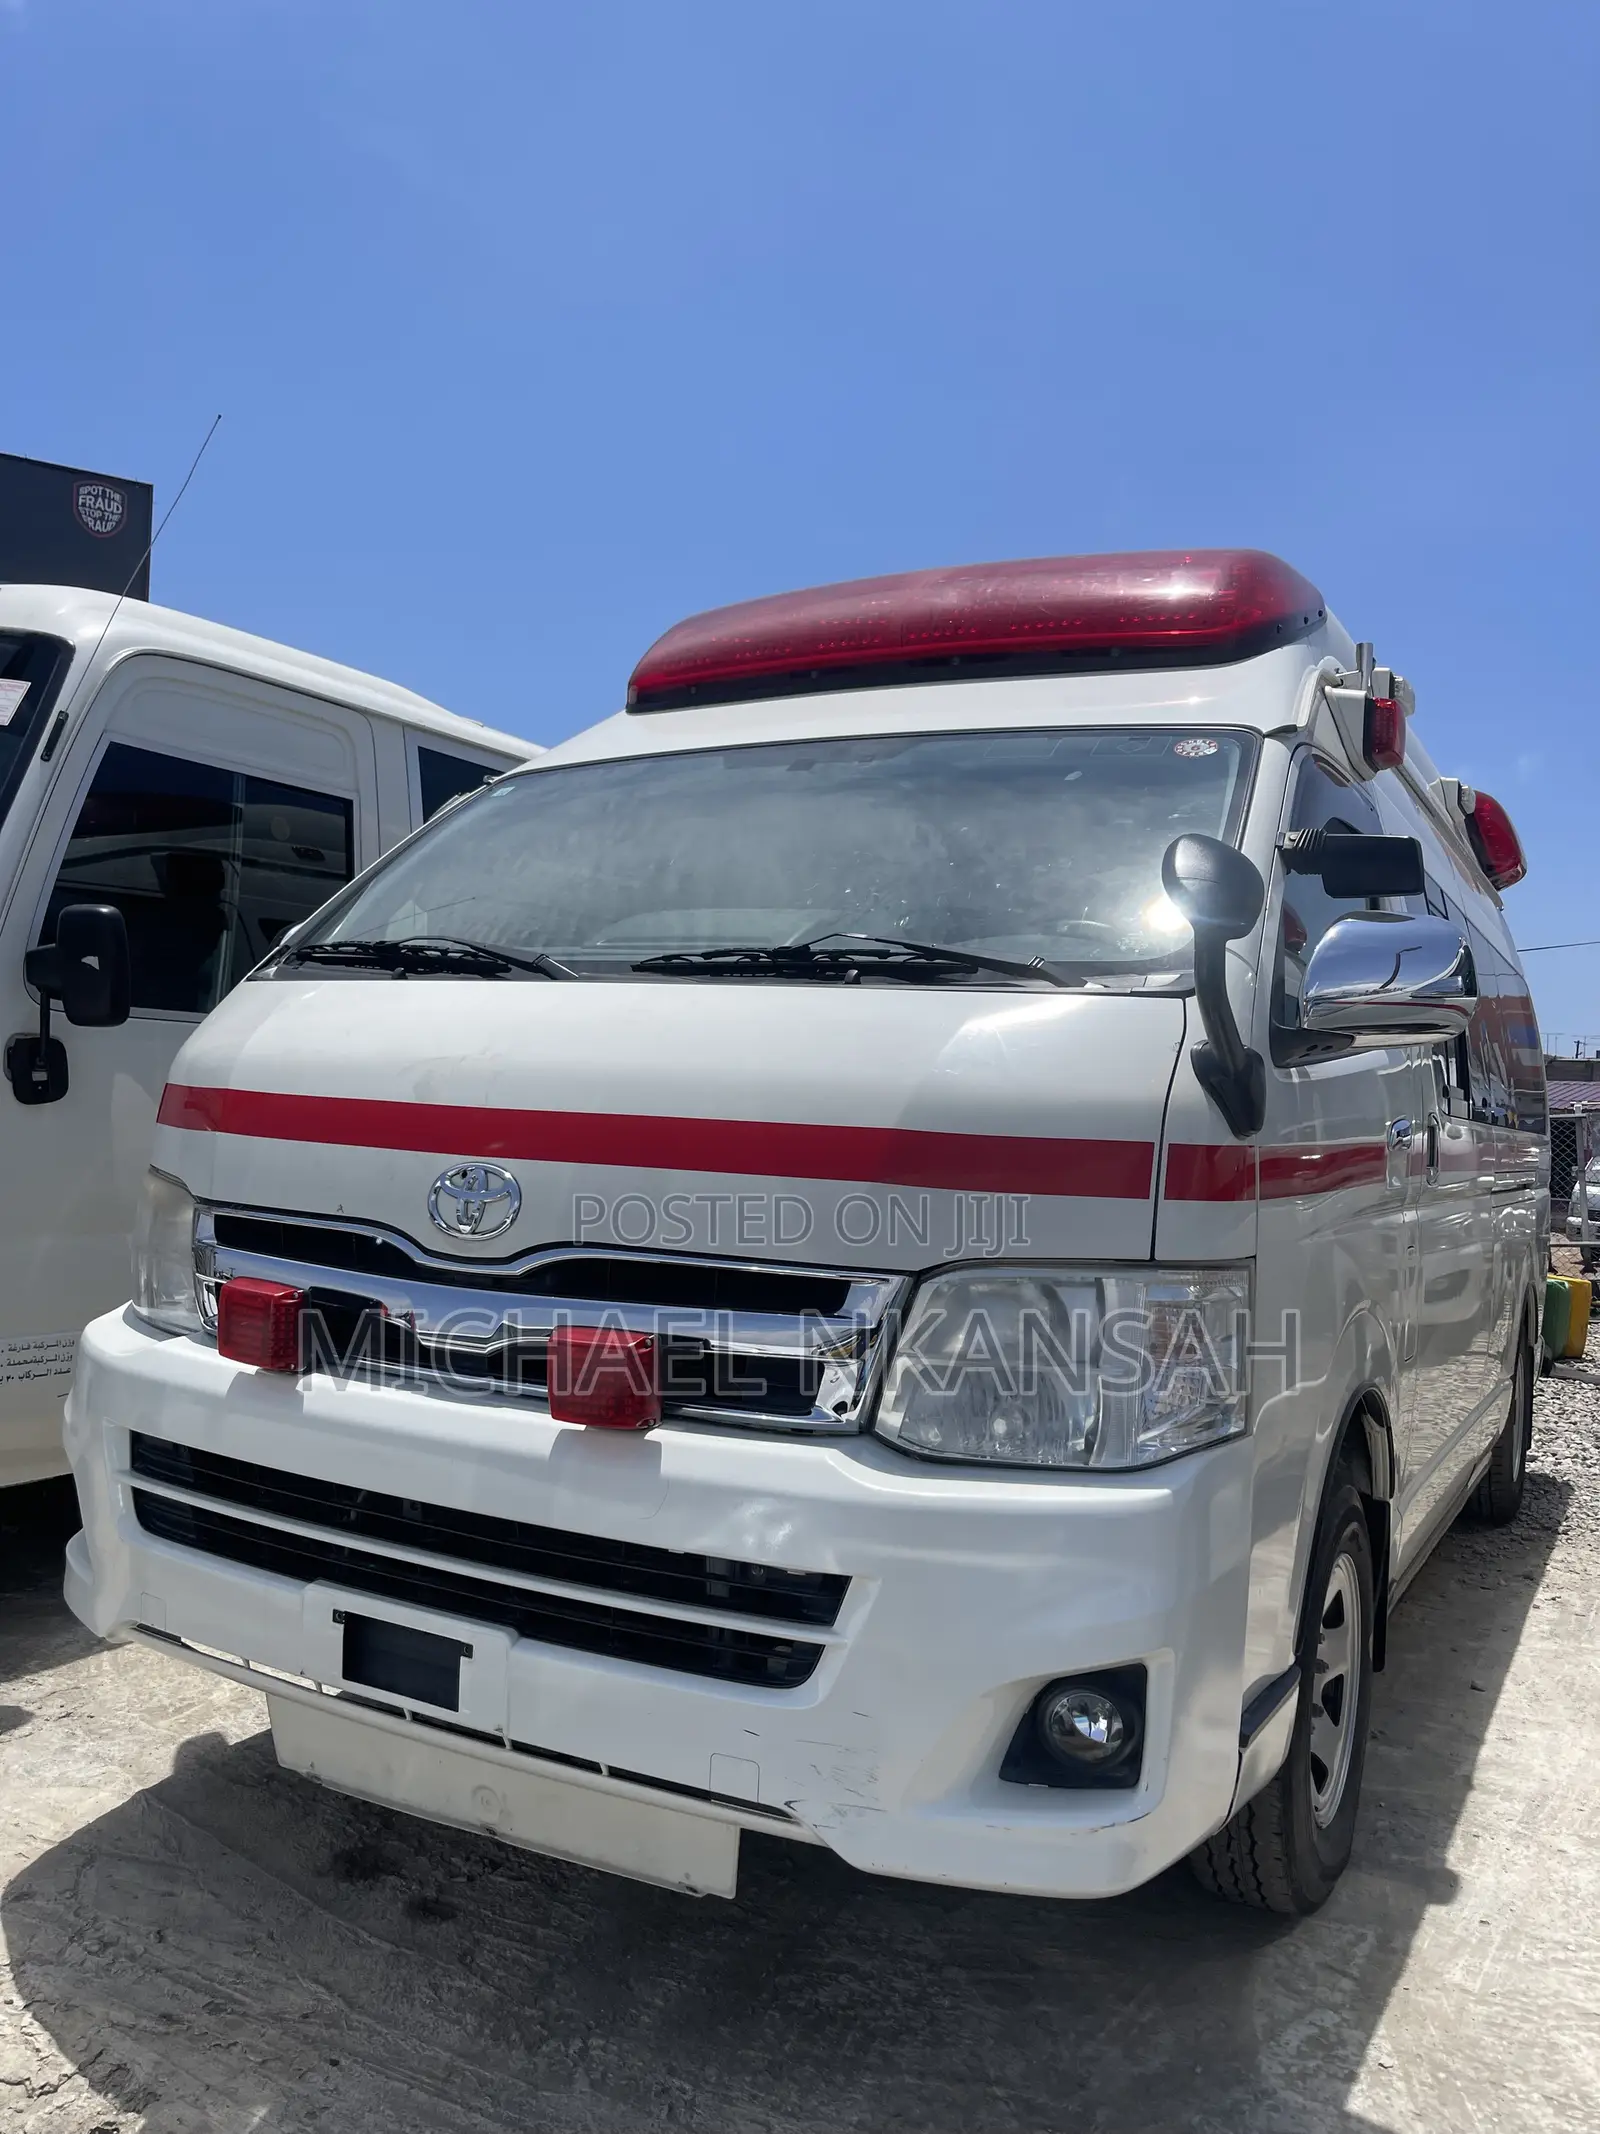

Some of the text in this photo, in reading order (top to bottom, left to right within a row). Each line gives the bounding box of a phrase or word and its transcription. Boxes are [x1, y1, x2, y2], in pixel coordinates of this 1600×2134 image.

[79, 485, 122, 502] SPOT THE
[78, 495, 123, 514] FRAUD
[78, 506, 102, 518] STOP
[81, 514, 117, 533] FRAUD
